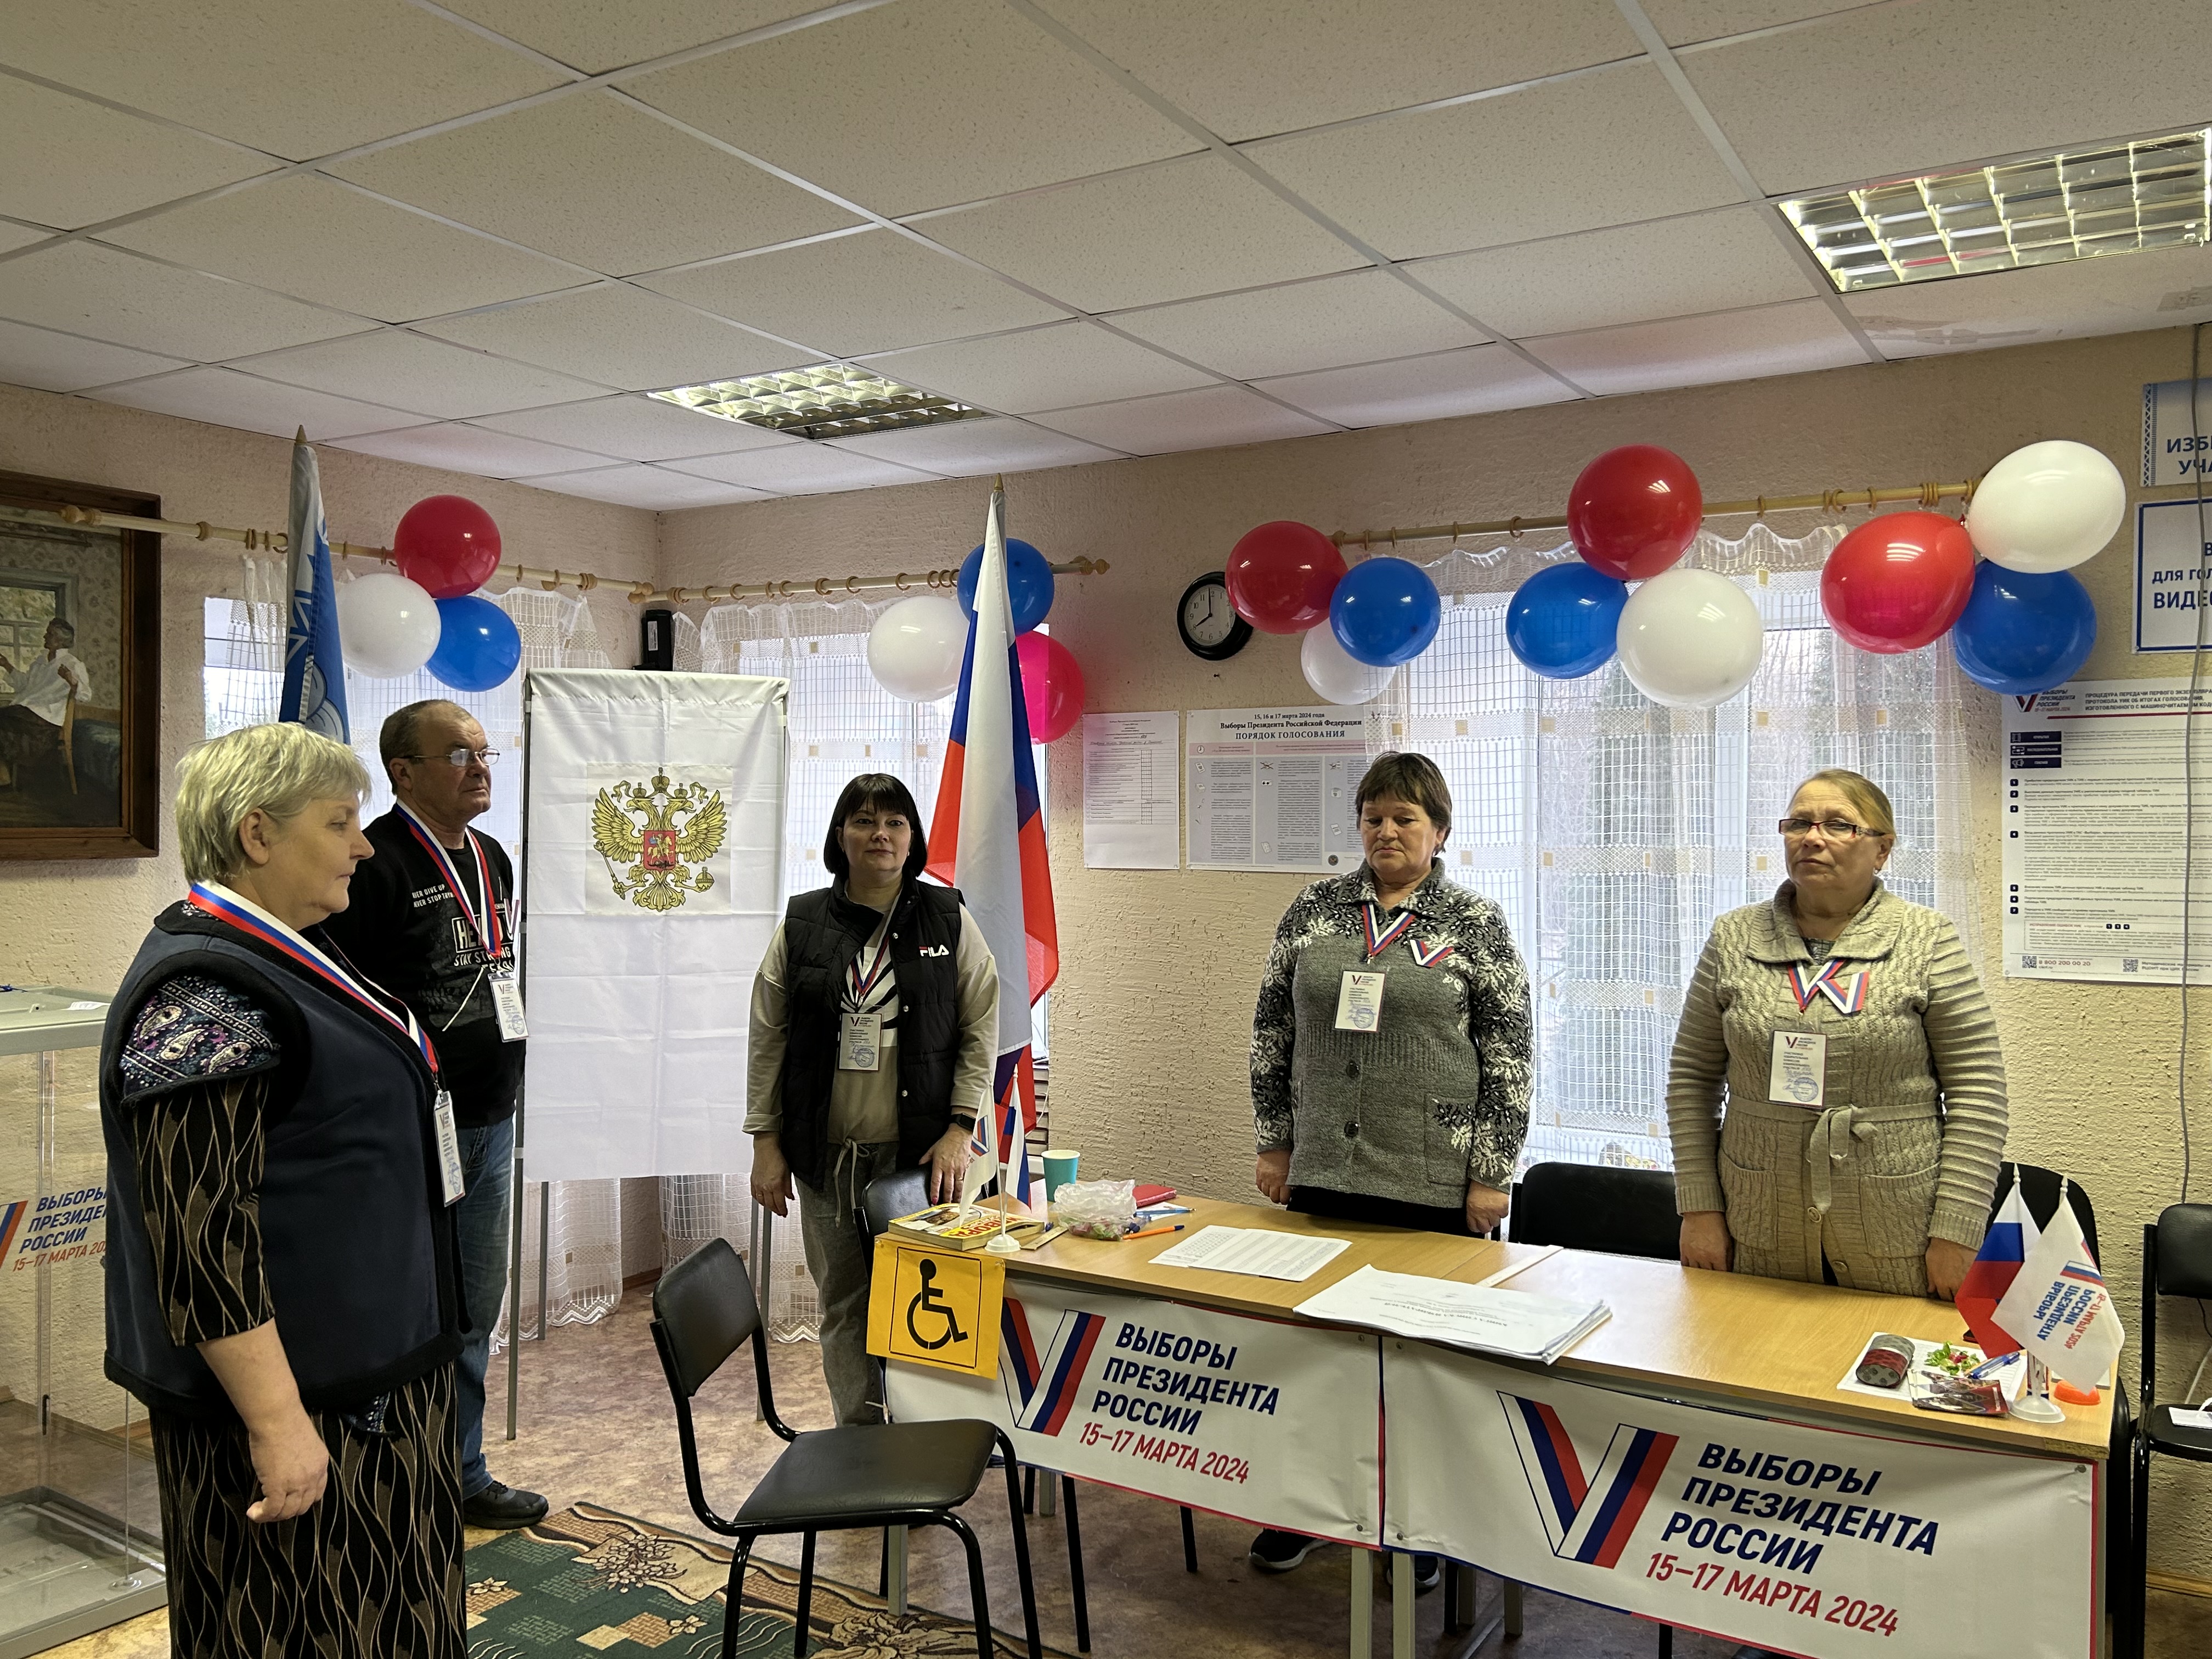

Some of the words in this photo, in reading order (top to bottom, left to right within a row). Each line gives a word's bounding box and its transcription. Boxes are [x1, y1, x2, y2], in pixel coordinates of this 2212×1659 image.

[2166, 436, 2212, 453] ИЗБ
[2152, 570, 2183, 584] для
[2154, 590, 2212, 610] ВИДЕ
[1278, 730, 1345, 738] ГОЛОСОВАНИЯ
[427, 894, 441, 904] STOP
[454, 953, 471, 967] STAY
[475, 946, 511, 963] STRNG
[919, 944, 950, 957] FILA
[27, 1205, 106, 1233] ПРЕЗИДЕ
[19, 1227, 88, 1254] РОССИИ
[47, 1244, 88, 1265] МАРТА
[89, 1240, 106, 1255] 20
[1115, 1322, 1238, 1370] ВЫБОРЫ
[1102, 1357, 1280, 1415] ПРЕЗИДЕНТА
[1091, 1390, 1203, 1436] РОССИИ
[1133, 1437, 1200, 1471] МАРТА
[1200, 1451, 1249, 1485] 2024
[1697, 1442, 1882, 1496] ВЫБОРЫ
[1681, 1476, 1939, 1556] ПРЕЗИДЕНТА
[1661, 1511, 1824, 1575] РОССИИ
[1723, 1570, 1821, 1619] МАРТА
[1825, 1594, 1900, 1638] 2024
